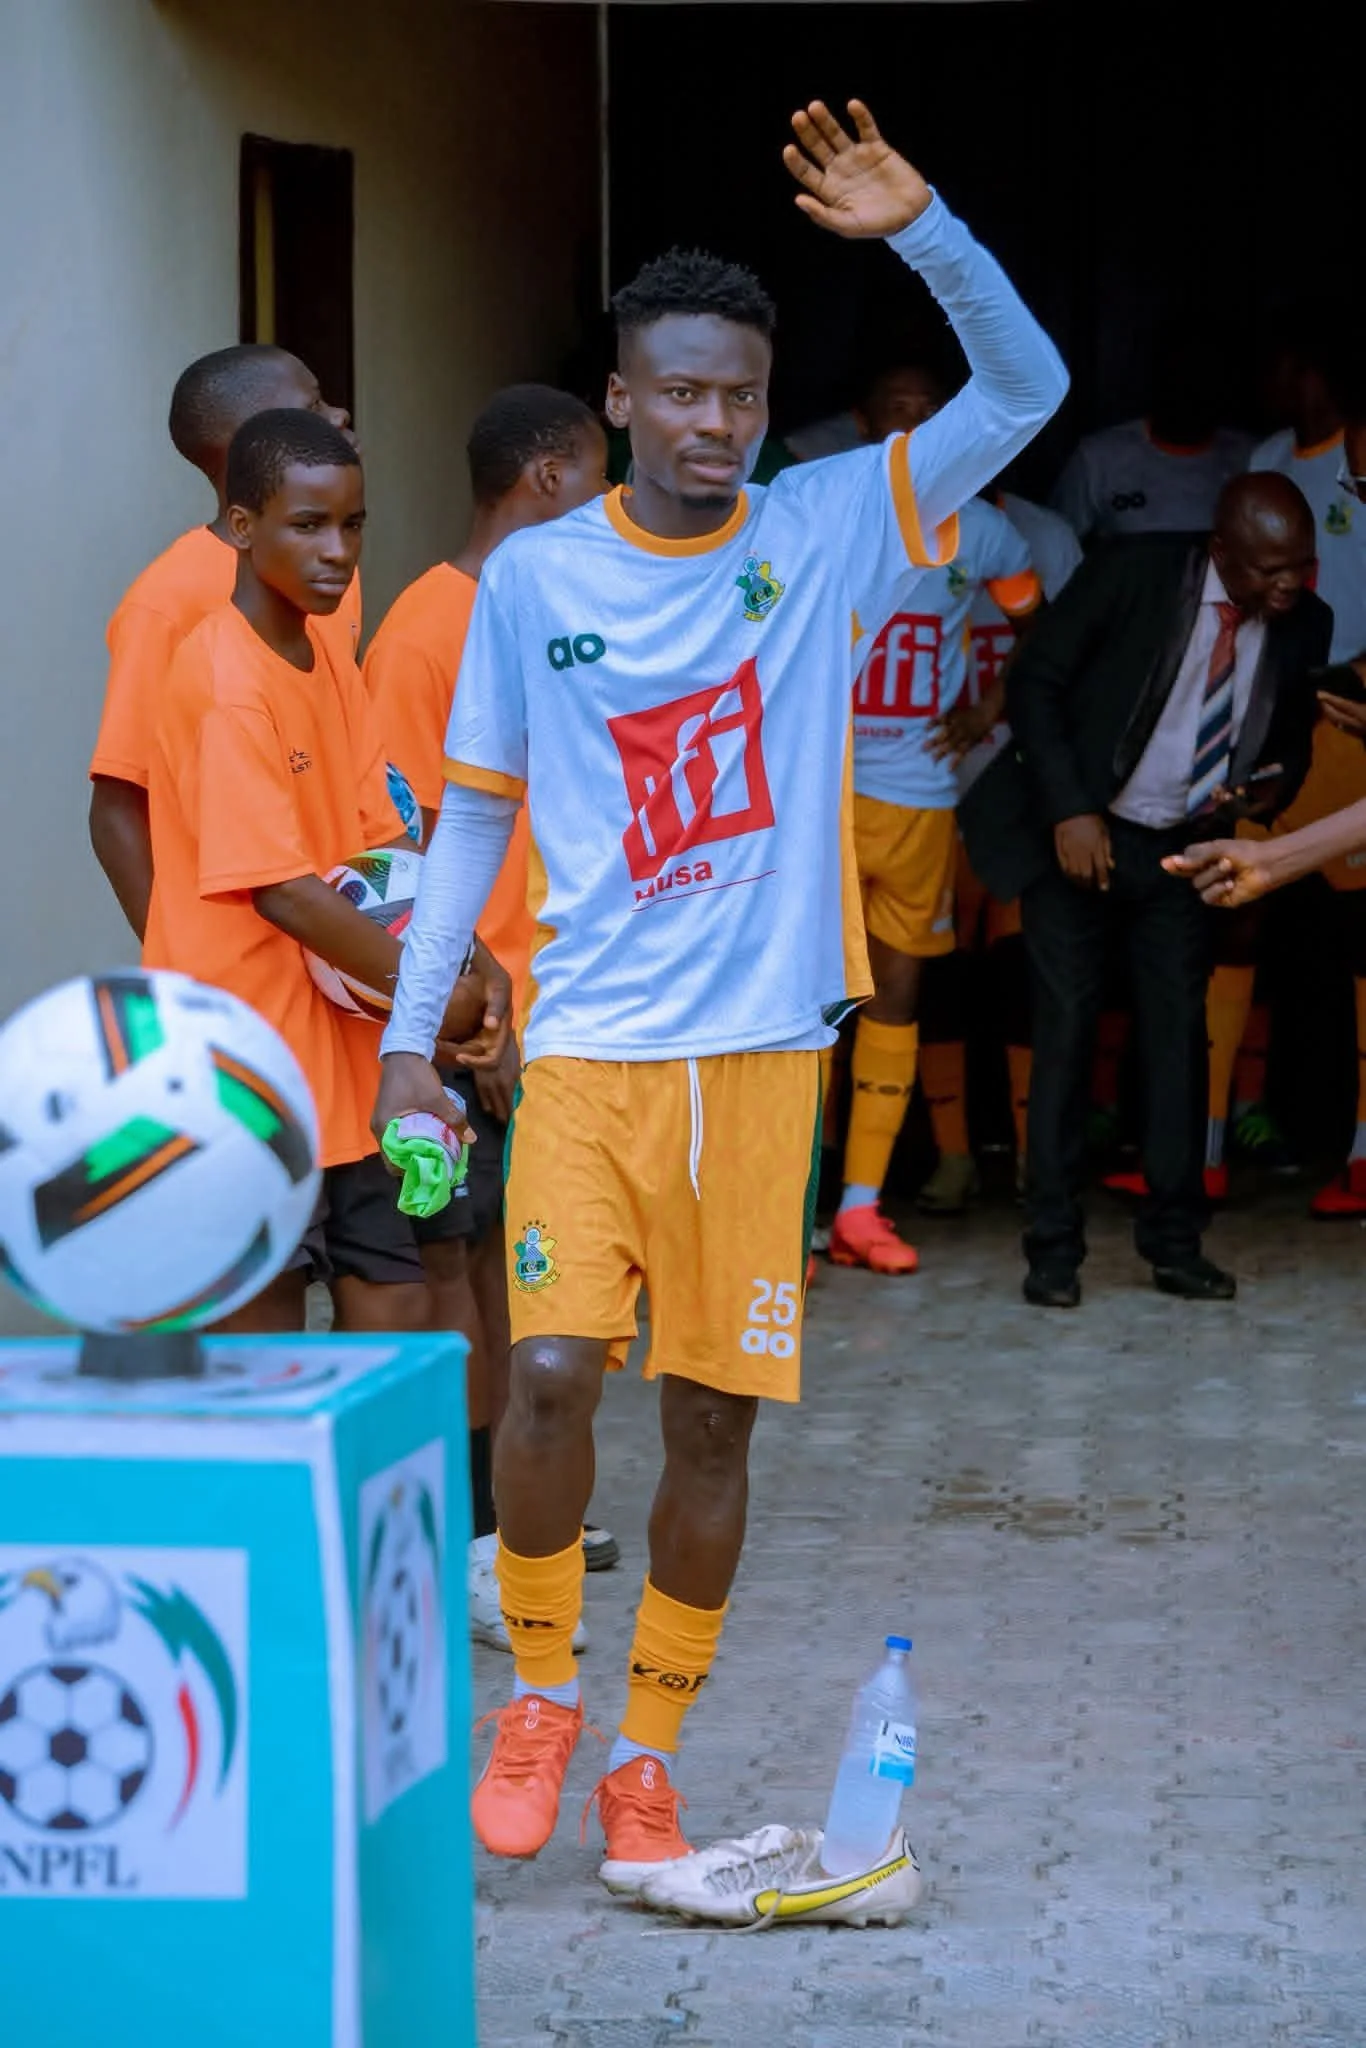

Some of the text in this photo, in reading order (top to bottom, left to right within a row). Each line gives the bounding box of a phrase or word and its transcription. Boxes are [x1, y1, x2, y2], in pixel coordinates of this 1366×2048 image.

[547, 633, 606, 671] ao
[859, 623, 936, 707] rfi
[855, 727, 904, 737] ausa
[748, 1278, 796, 1326] 25
[741, 1328, 795, 1358] ao
[0, 1845, 139, 1888] NPFL
